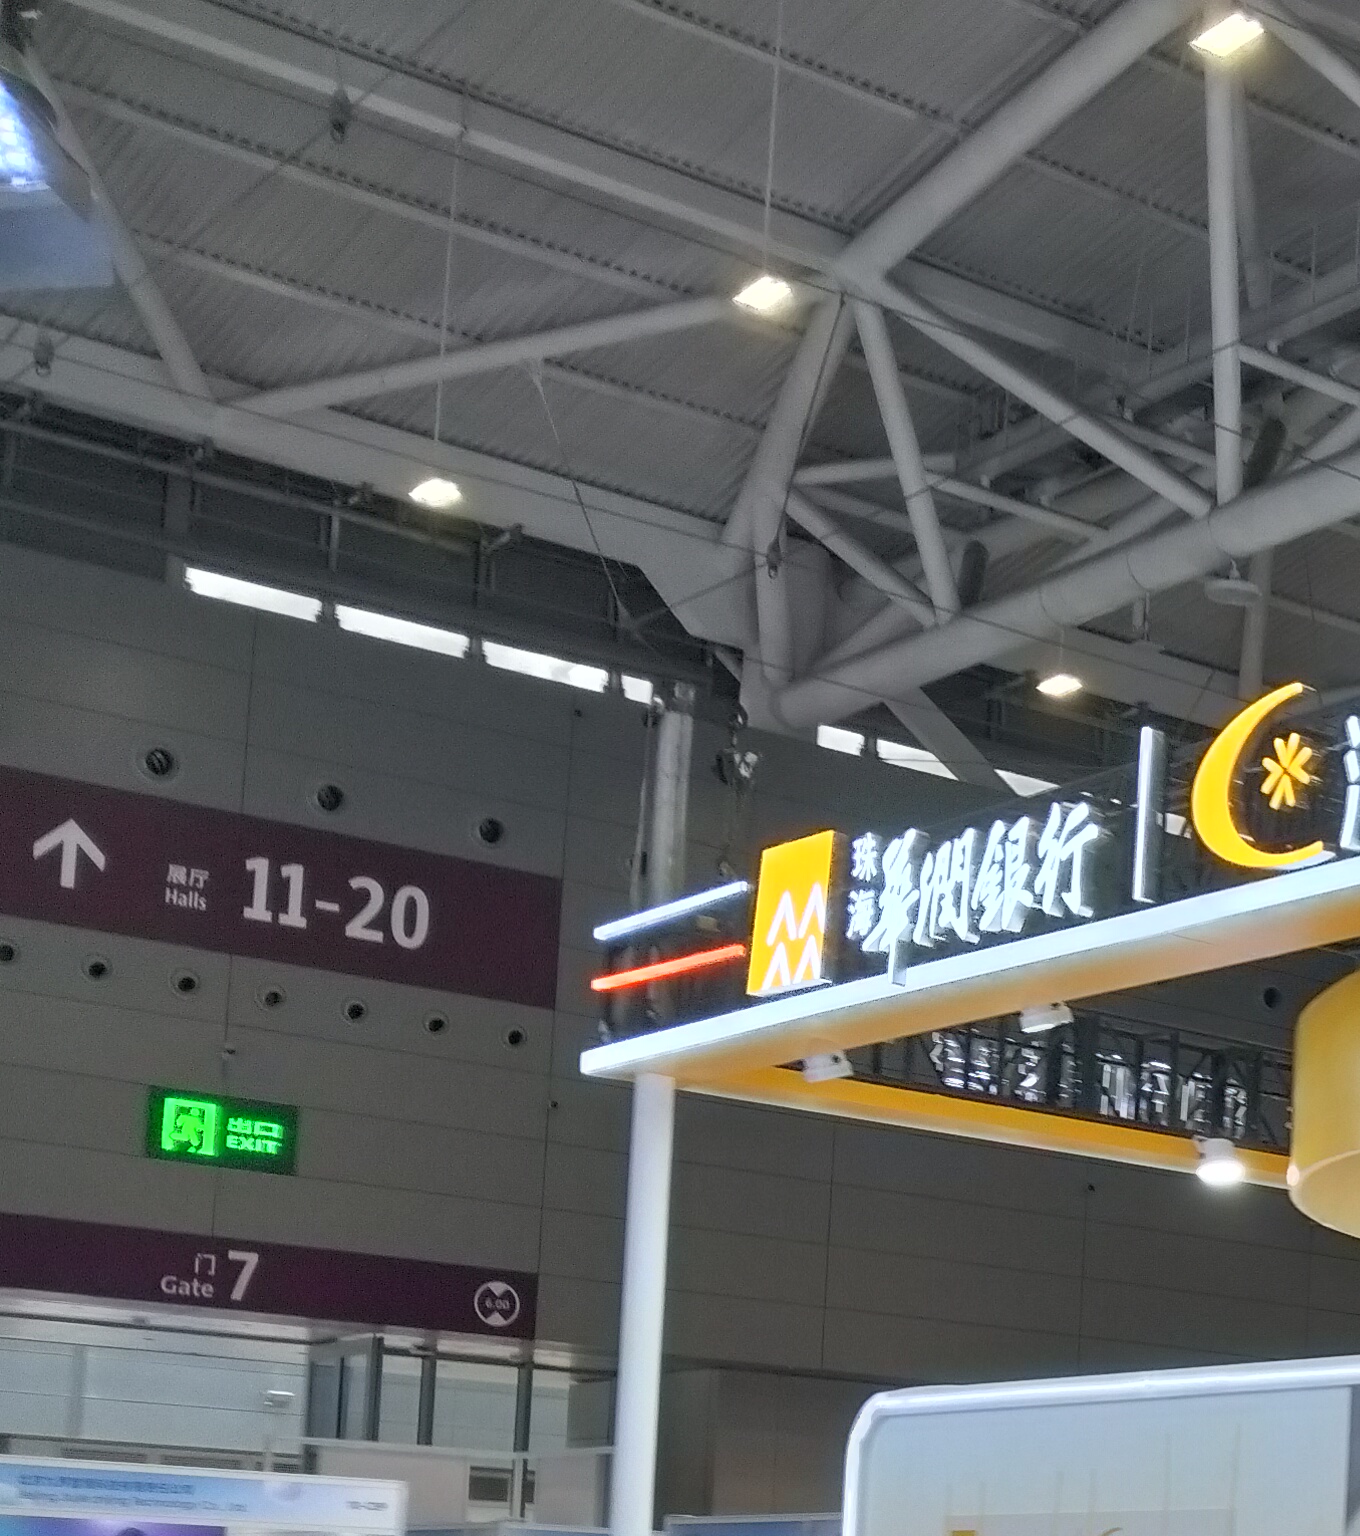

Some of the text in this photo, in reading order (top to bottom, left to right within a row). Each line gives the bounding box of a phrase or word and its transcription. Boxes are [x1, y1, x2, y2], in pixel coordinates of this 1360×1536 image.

[167, 863, 210, 890] 展厅
[848, 831, 879, 940] 珠海
[165, 886, 208, 912] Halls
[242, 856, 430, 950] 11-20
[226, 1117, 284, 1140] 出口
[226, 1135, 283, 1155] EXIT
[194, 1252, 217, 1277] 门
[227, 1250, 260, 1301] 7
[160, 1275, 215, 1299] Gate
